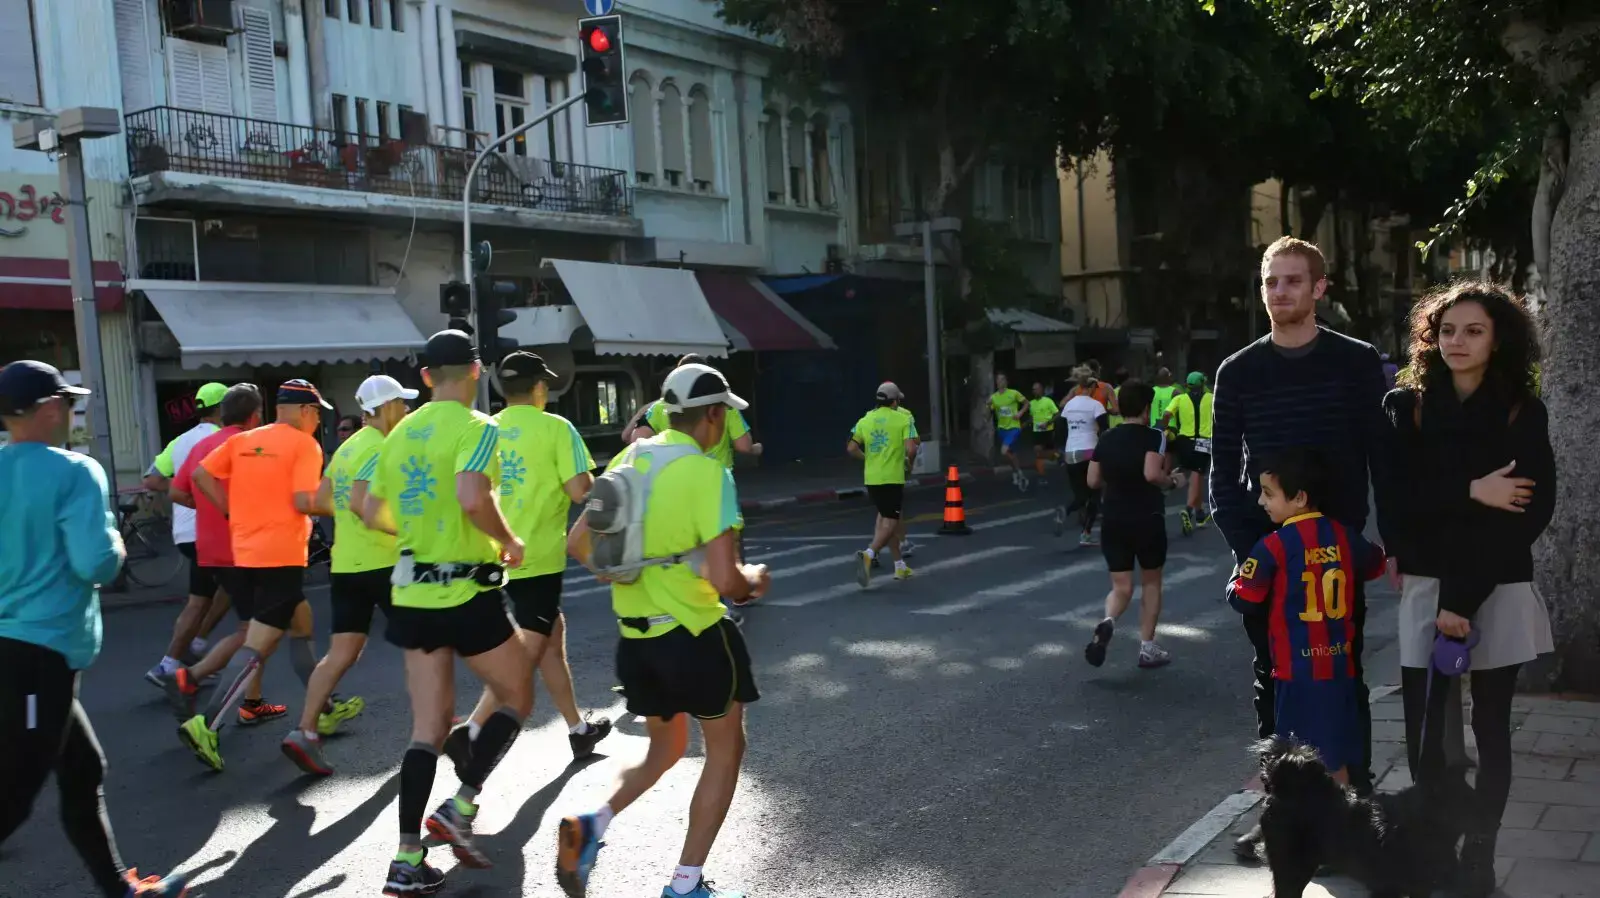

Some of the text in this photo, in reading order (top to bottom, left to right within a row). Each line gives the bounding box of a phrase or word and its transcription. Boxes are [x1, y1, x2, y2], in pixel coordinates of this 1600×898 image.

[1304, 545, 1342, 566] MESSI
[1299, 568, 1347, 622] 10
[1302, 642, 1341, 657] unicef
